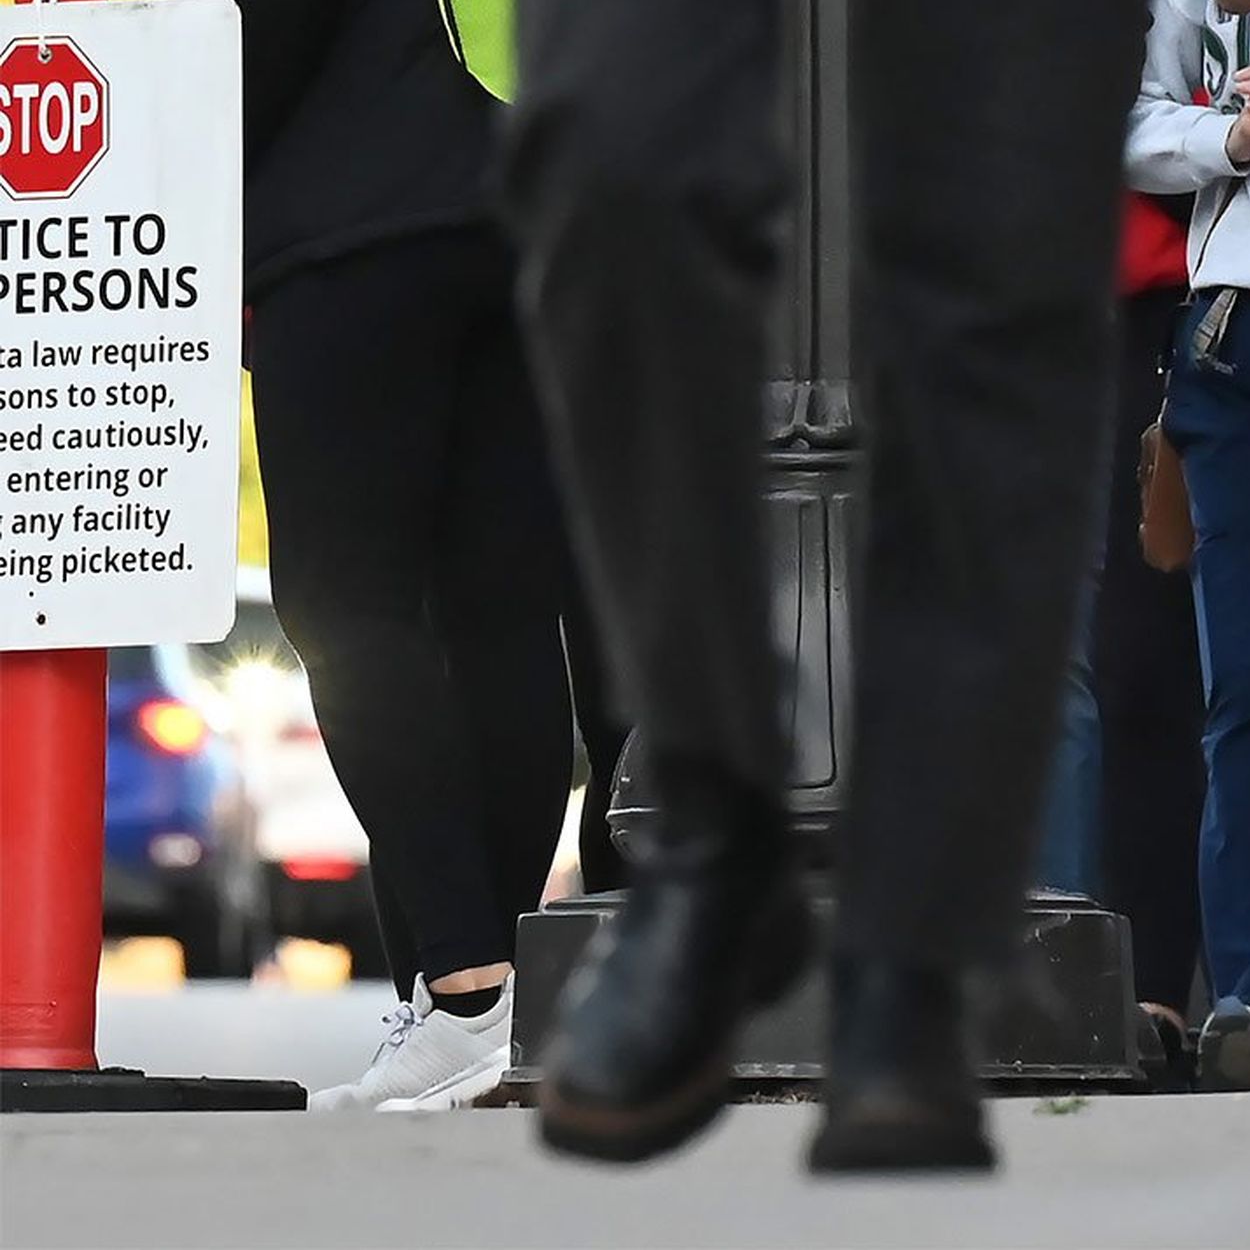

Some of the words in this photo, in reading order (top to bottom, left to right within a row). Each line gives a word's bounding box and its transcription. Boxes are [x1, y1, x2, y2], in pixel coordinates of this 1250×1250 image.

[104, 213, 166, 257] TO
[32, 340, 82, 368] law
[92, 335, 210, 372] requires
[67, 384, 96, 407] to
[105, 382, 175, 412] stop,
[52, 418, 208, 453] cautiously,
[7, 463, 130, 497] entering
[138, 466, 168, 488] or
[11, 512, 64, 541] any
[73, 503, 170, 537] facility
[62, 543, 193, 582] picketed.
